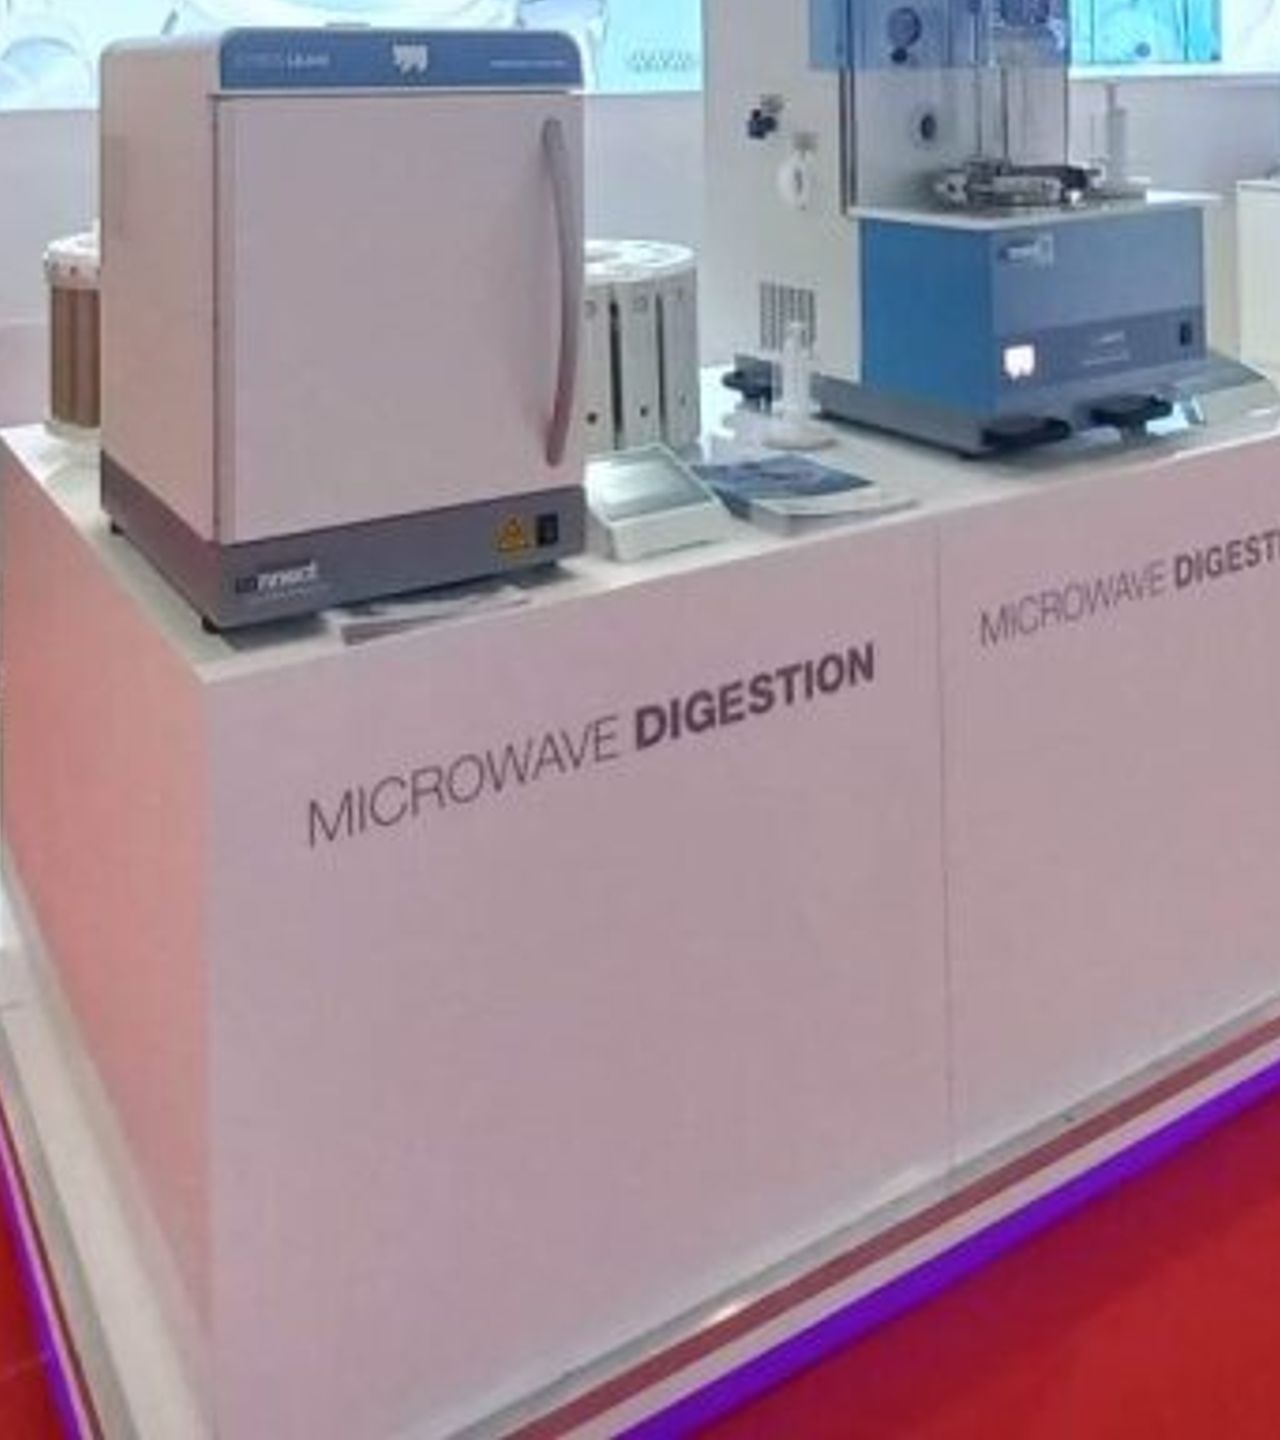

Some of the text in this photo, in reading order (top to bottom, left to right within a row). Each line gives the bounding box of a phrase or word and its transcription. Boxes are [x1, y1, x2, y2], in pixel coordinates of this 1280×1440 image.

[978, 560, 1170, 647] MICROWAVE
[306, 642, 877, 849] MICROWAVE DIGESTION
